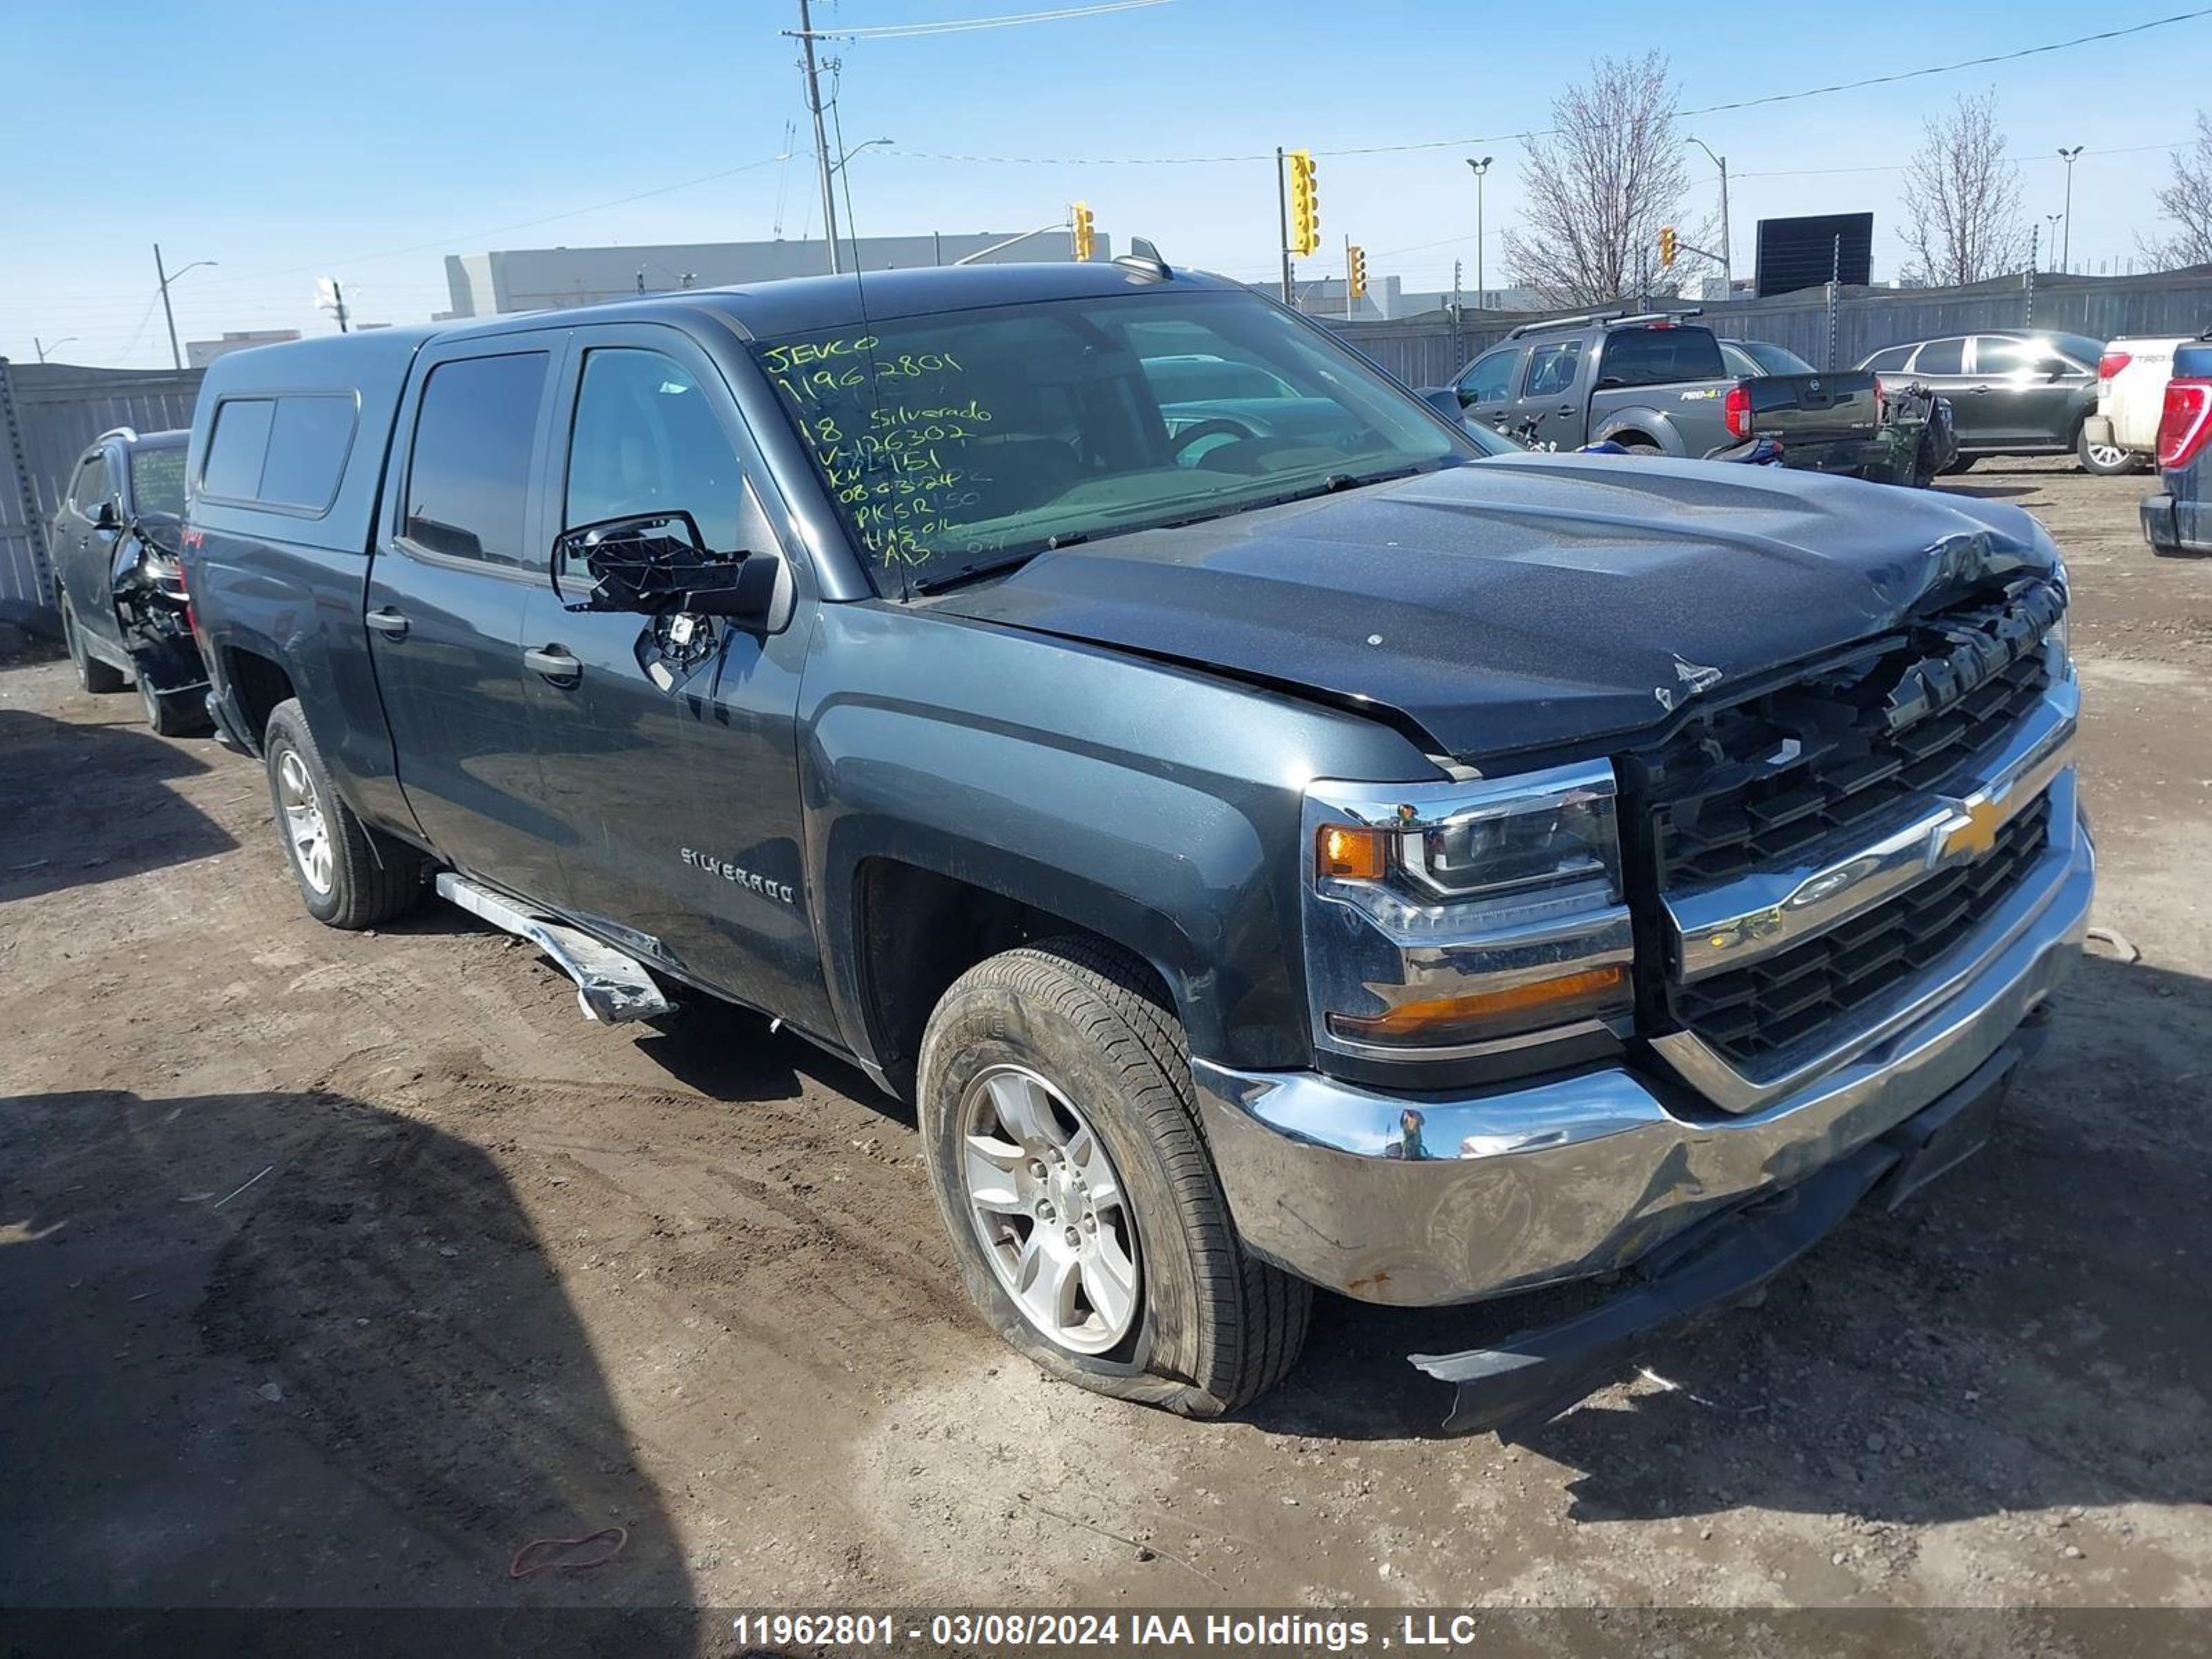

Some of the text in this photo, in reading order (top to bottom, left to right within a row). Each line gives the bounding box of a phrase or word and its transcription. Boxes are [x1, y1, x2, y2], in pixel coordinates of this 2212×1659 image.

[799, 400, 992, 446] 18 Silverado
[680, 847, 795, 903] SILVERADO
